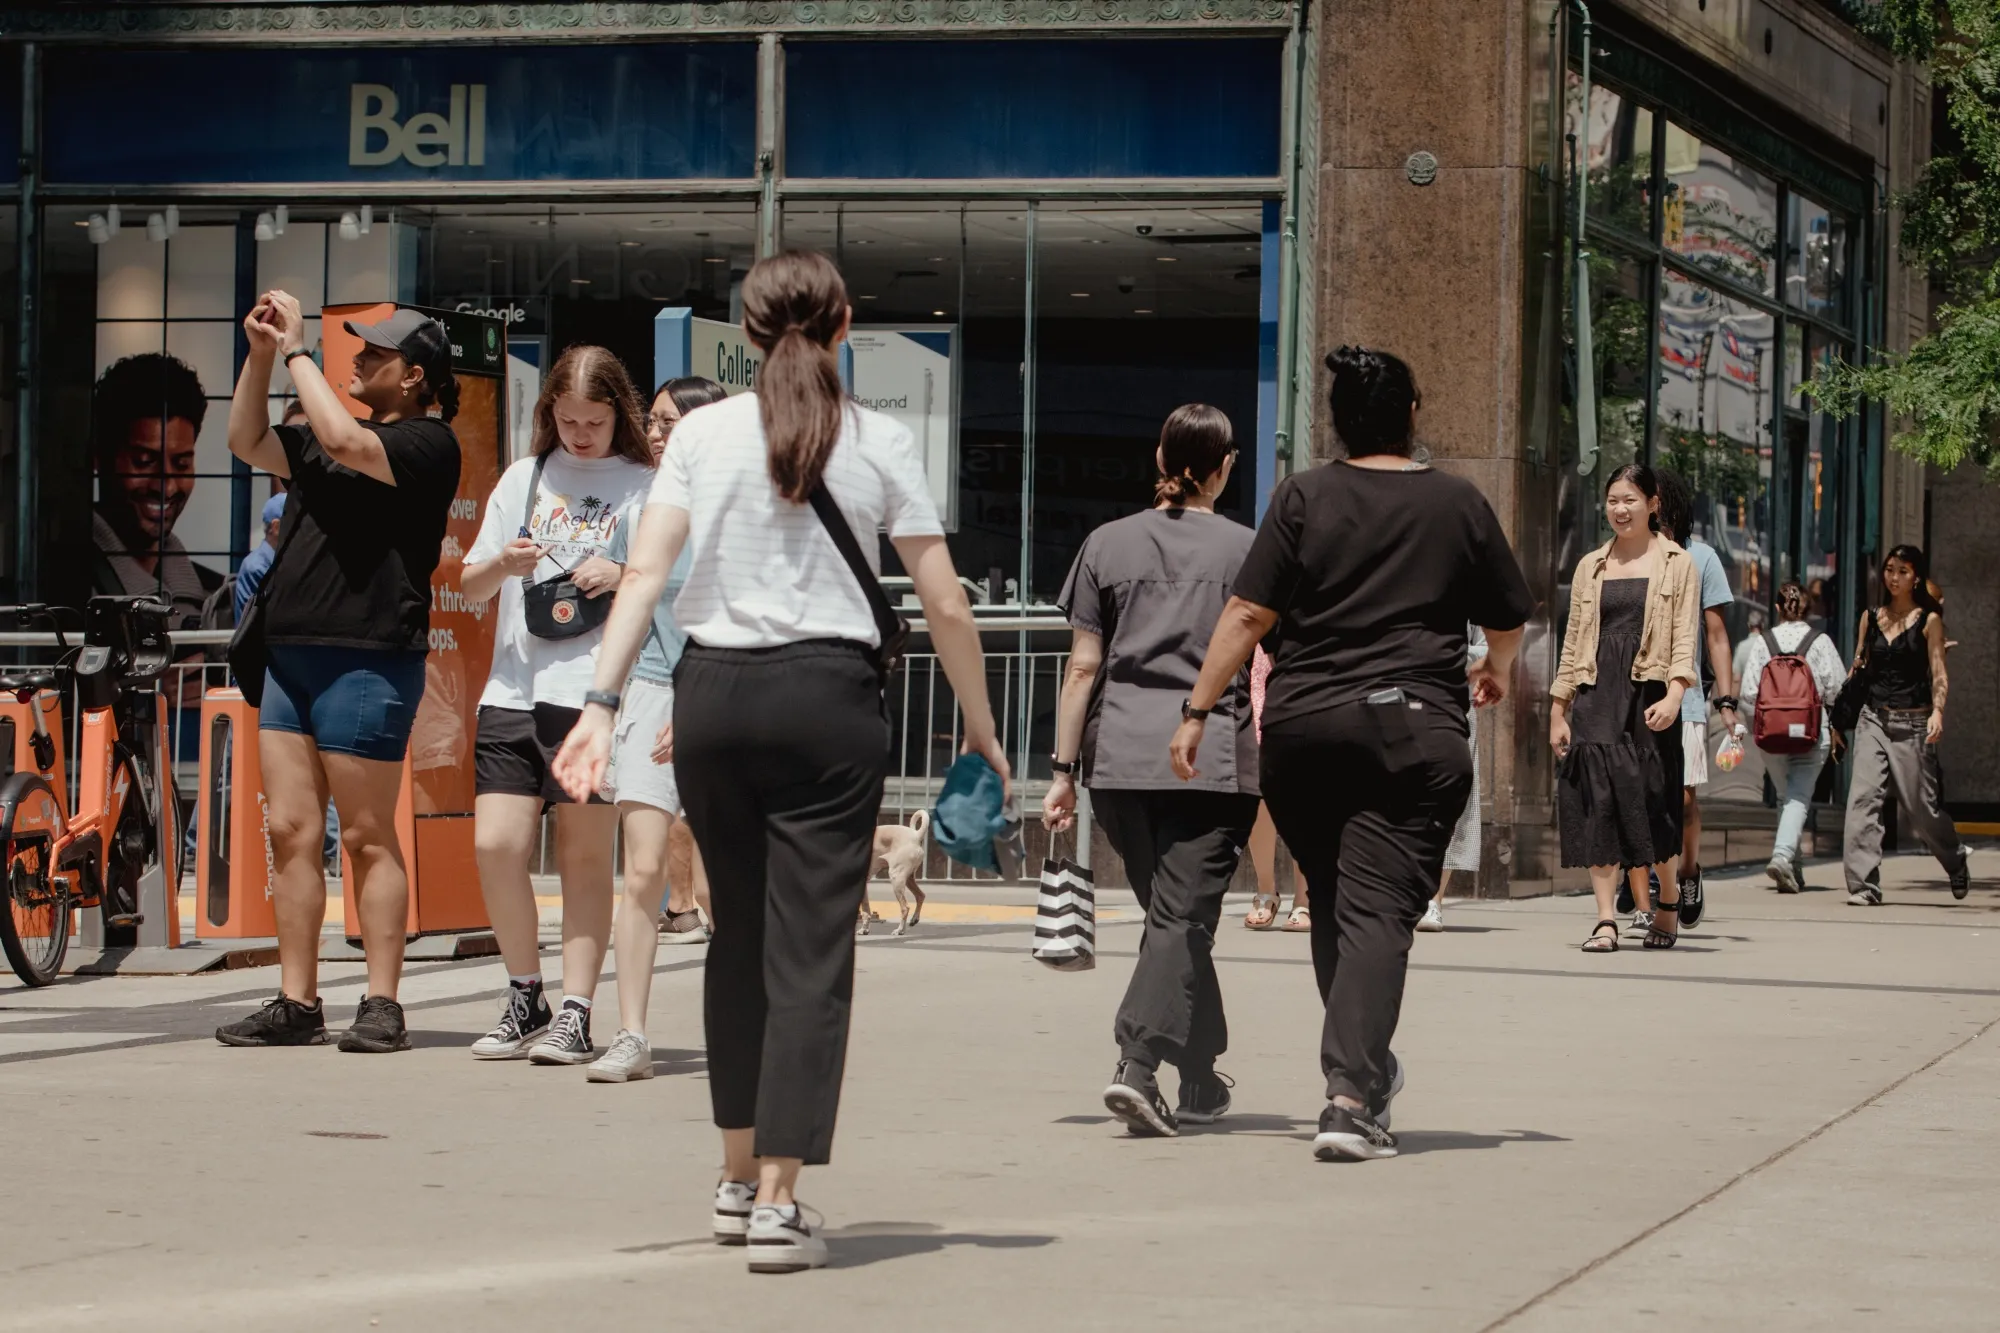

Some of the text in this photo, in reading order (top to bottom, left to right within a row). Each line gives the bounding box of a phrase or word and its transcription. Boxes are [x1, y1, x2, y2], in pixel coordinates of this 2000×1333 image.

[349, 84, 486, 167] Bell
[429, 627, 458, 656] ops.
[103, 752, 114, 817] Tangerine
[260, 802, 274, 901] Tangerine
